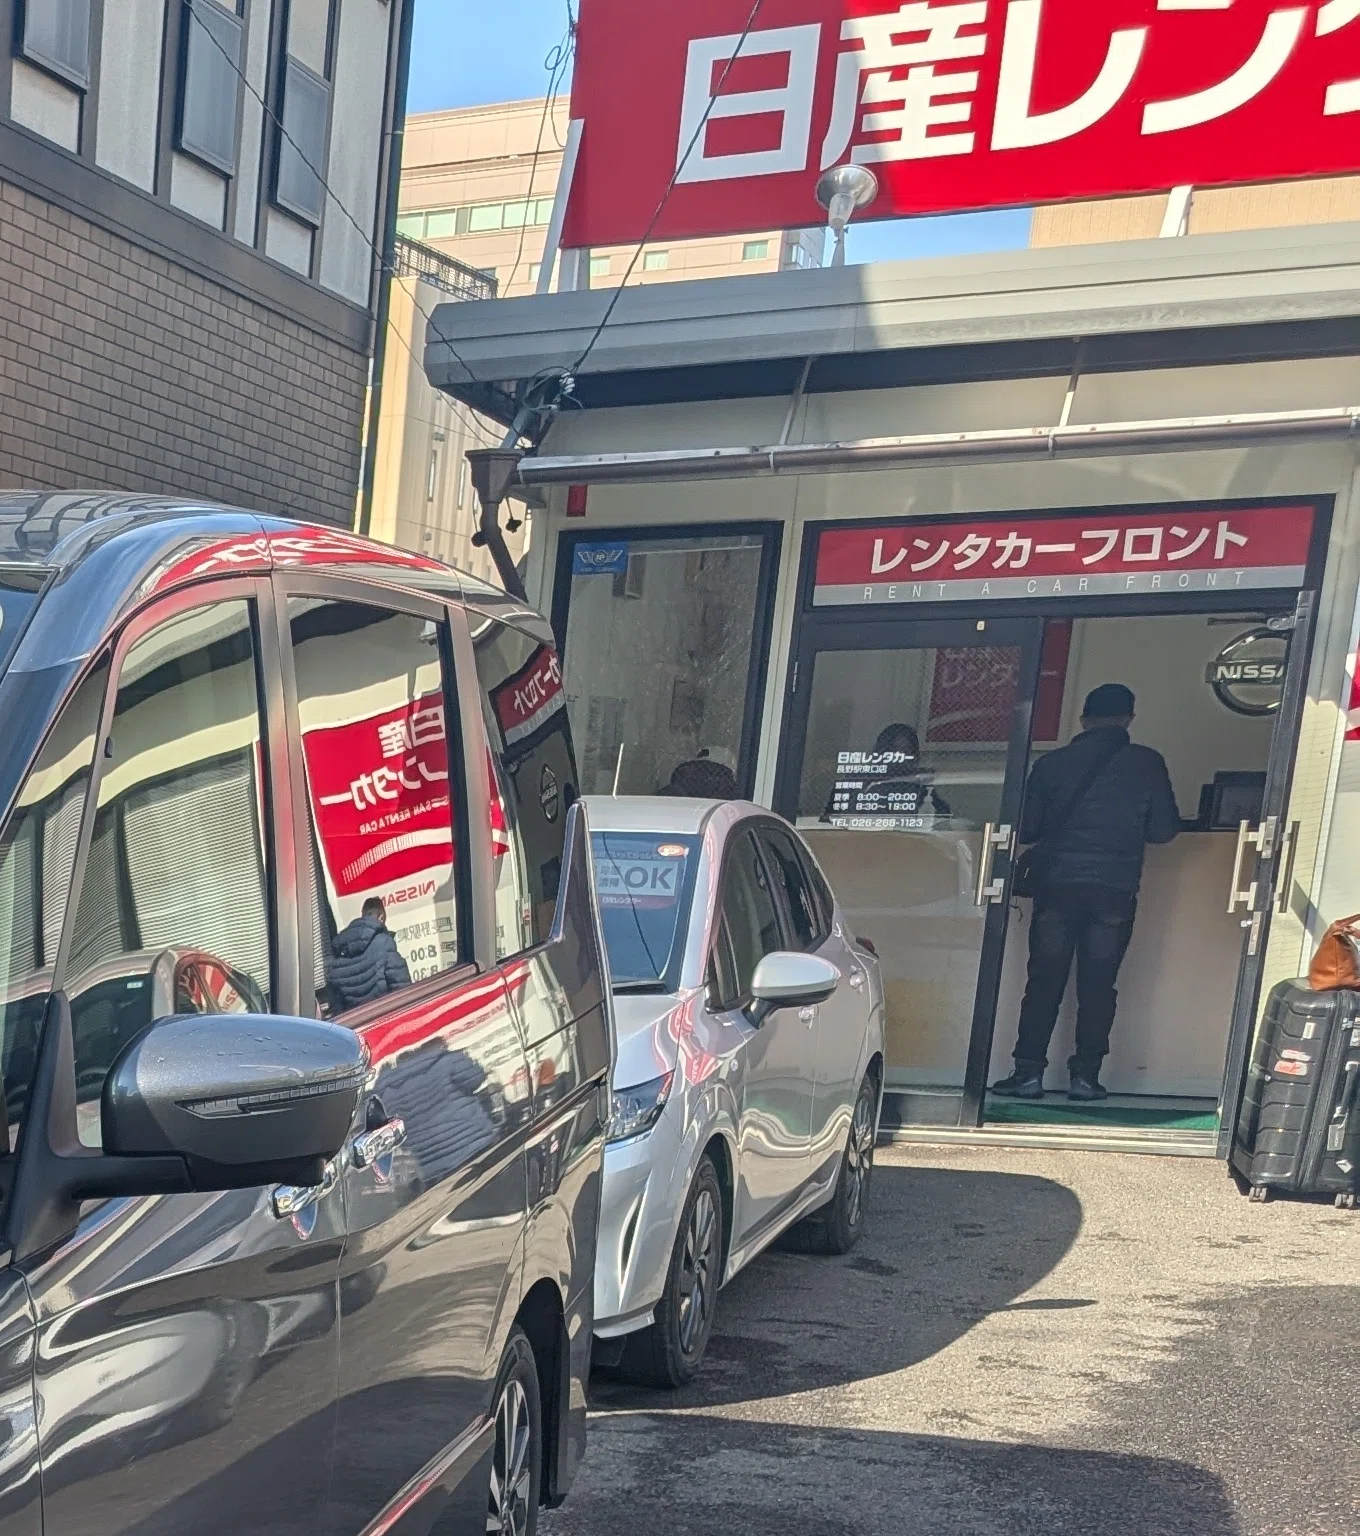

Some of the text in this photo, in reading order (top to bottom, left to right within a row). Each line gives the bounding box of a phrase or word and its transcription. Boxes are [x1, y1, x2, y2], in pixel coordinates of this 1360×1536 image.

[675, 0, 1360, 184] 日産レン
[870, 521, 1248, 574] レンタカーフロント
[863, 571, 1244, 600] RENT A CAR FRONT
[837, 751, 914, 763] 日産レンタカー
[831, 818, 849, 827] TEL
[624, 866, 674, 890] OK
